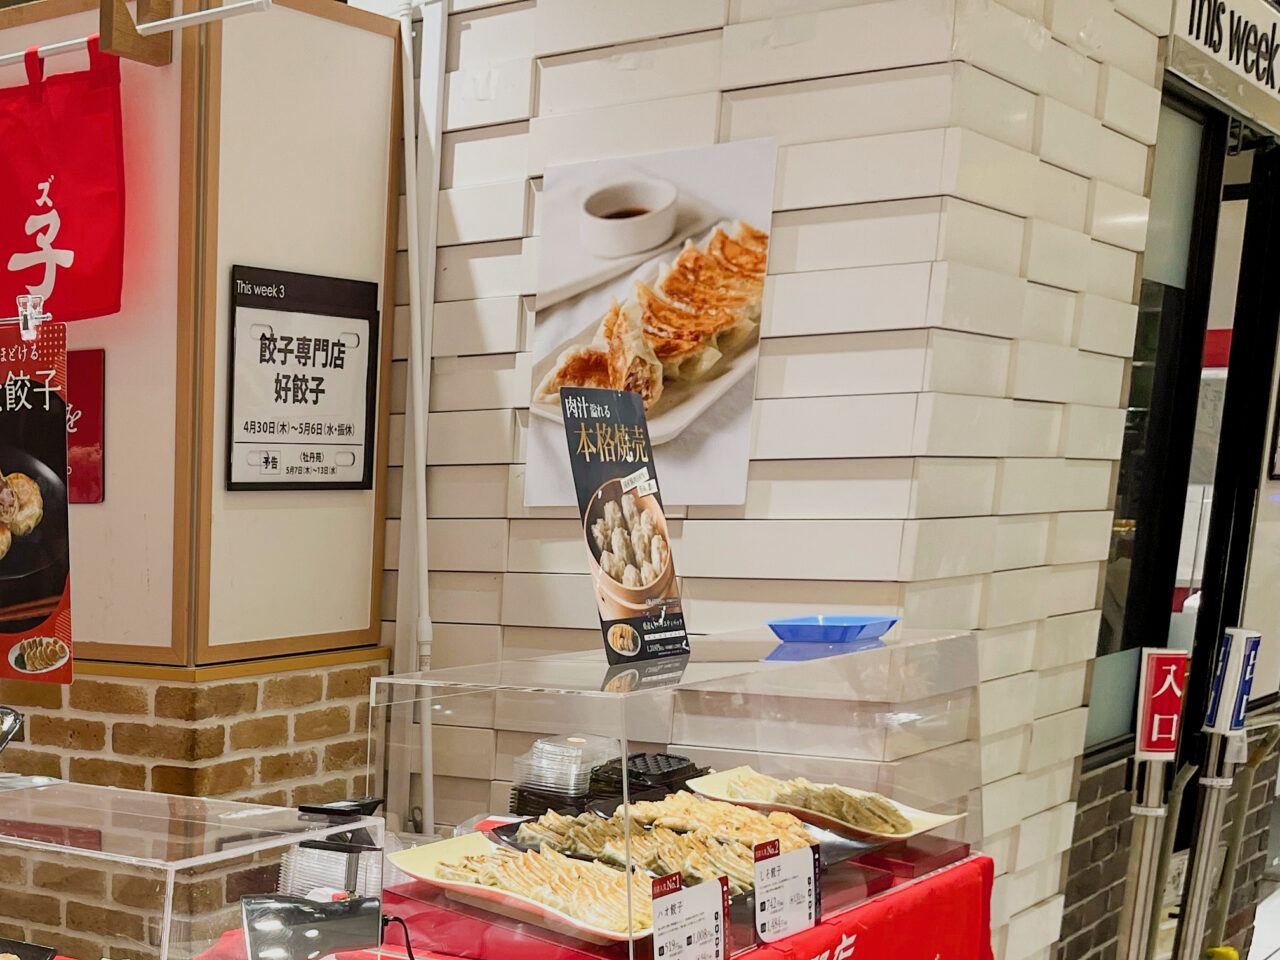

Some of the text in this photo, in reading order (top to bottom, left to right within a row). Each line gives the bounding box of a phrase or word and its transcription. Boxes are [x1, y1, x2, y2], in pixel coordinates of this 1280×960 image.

[1229, 10, 1280, 89] week
[35, 175, 55, 206] ズ
[237, 280, 285, 298] This week 3
[260, 333, 346, 369] 餃子専門店
[274, 373, 326, 405] 好餃子
[574, 422, 649, 464] 本格焼売
[1152, 664, 1182, 742] 入口
